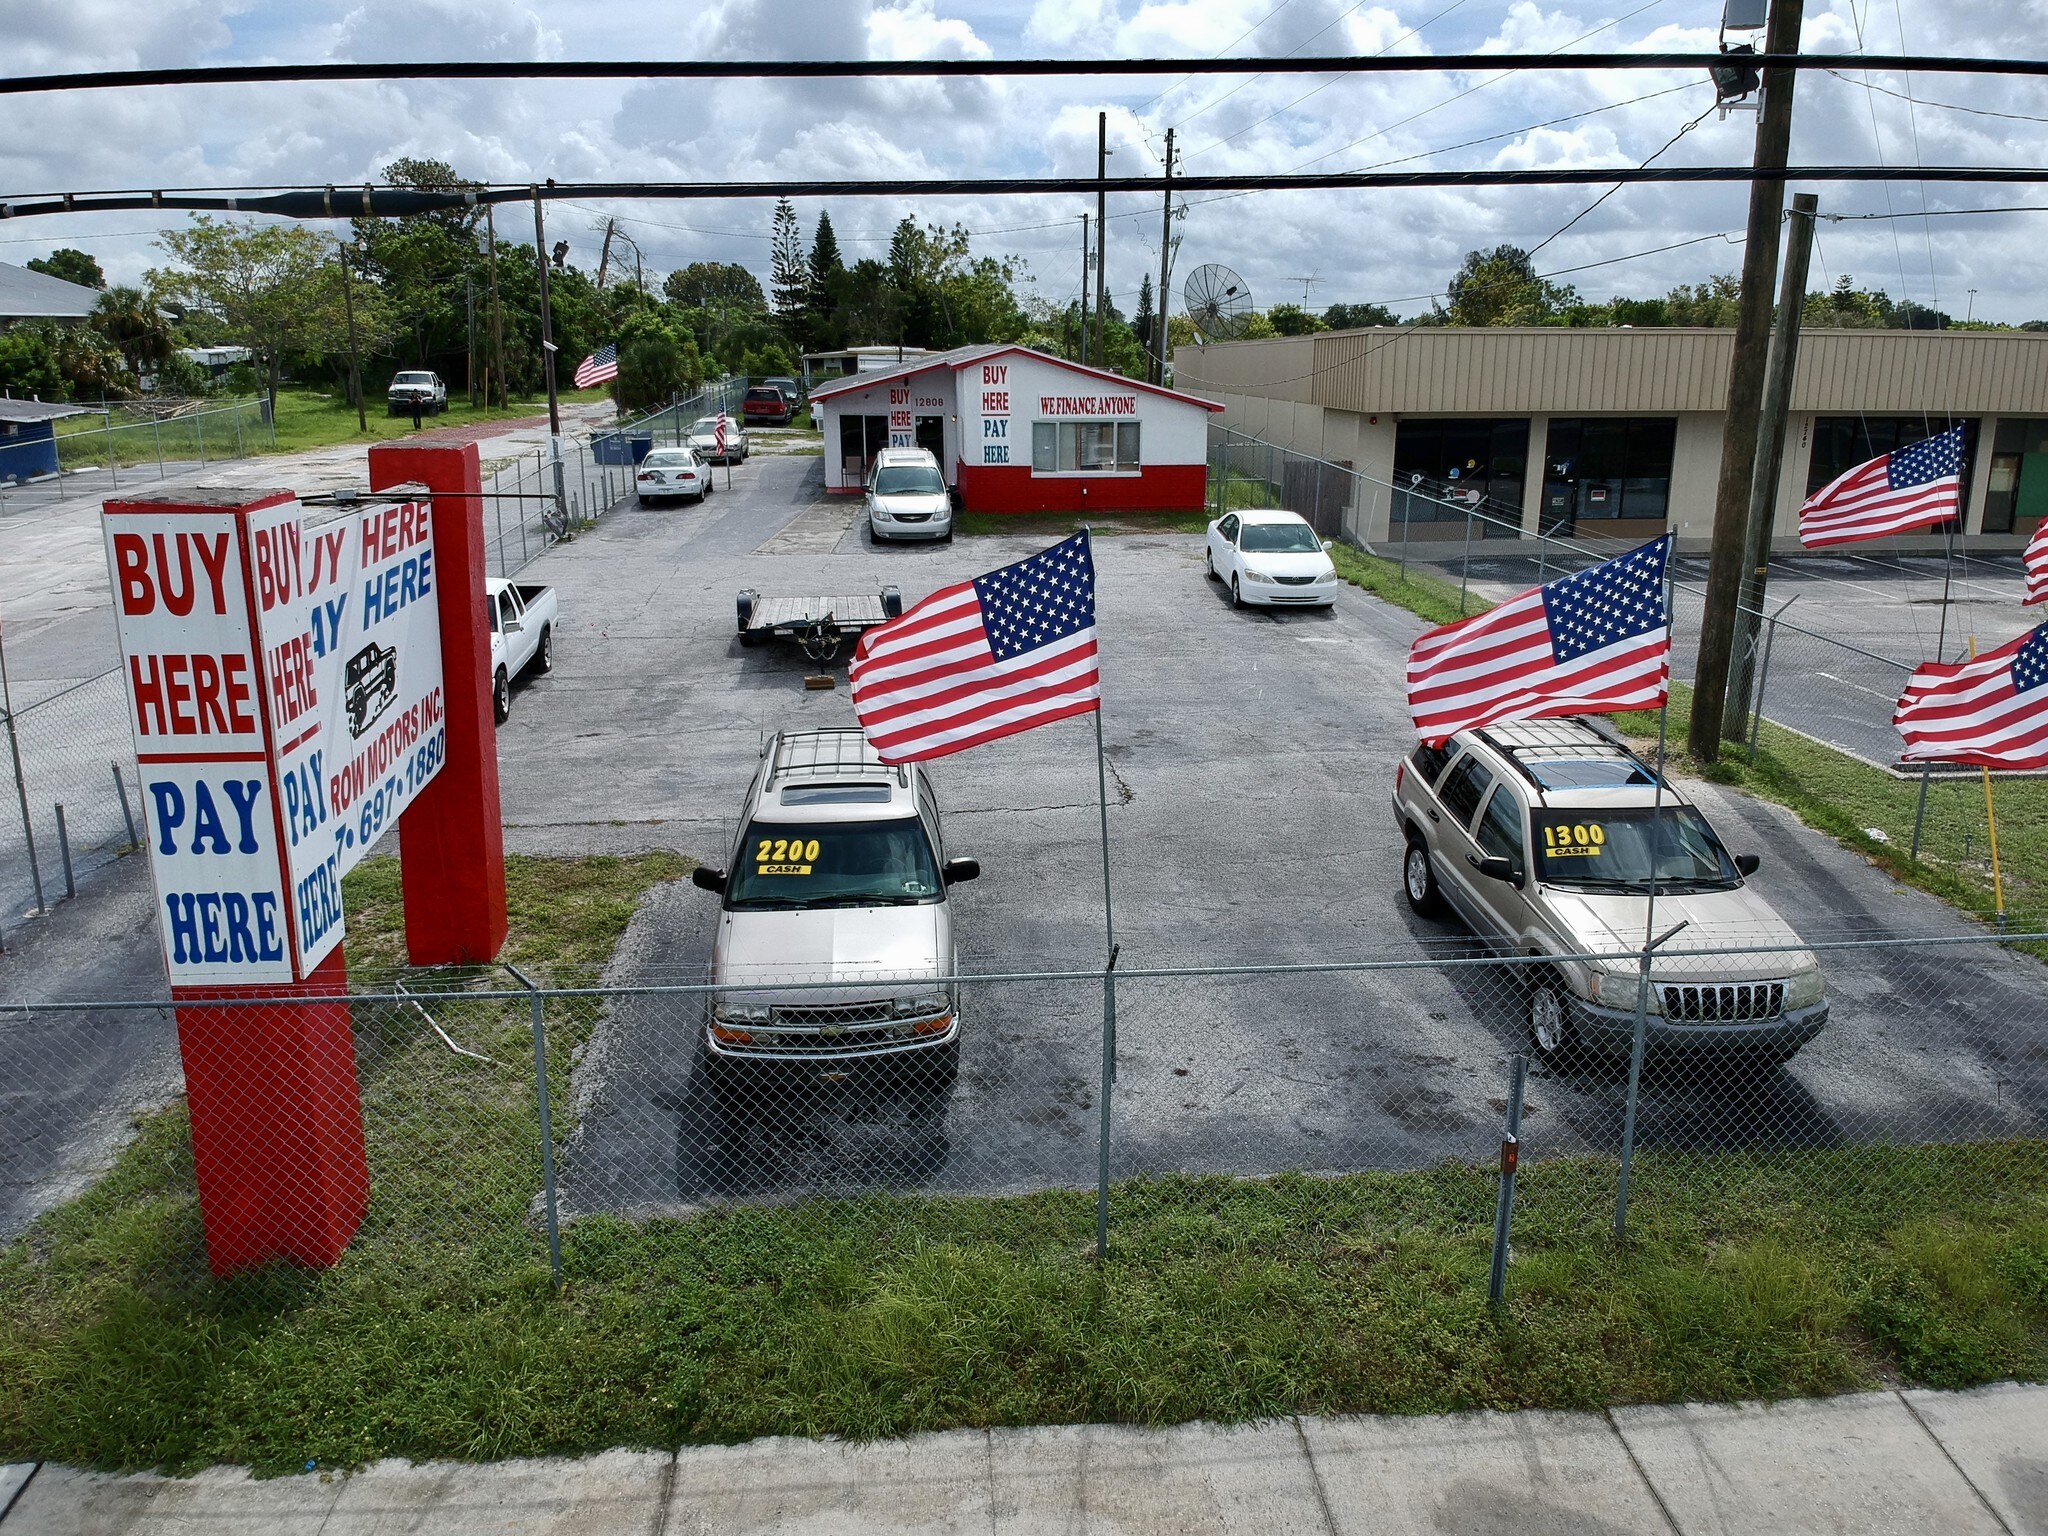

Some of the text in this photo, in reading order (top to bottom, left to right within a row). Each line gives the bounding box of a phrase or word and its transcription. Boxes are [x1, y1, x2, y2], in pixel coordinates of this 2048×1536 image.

[983, 365, 1008, 385] BUY
[890, 388, 911, 405] BUY
[915, 398, 944, 407] 12808
[982, 391, 1009, 411] HERE
[1040, 396, 1136, 415] WE FINANCE ANYONE
[891, 411, 911, 427] HERE
[984, 418, 1009, 438] PAY
[892, 434, 911, 448] PAY
[983, 445, 1010, 464] HERE
[304, 501, 428, 595] UY HERE
[114, 532, 230, 617] BUY
[255, 519, 303, 613] BUY
[311, 548, 432, 658] AY HERE
[268, 630, 317, 729] HERE
[130, 653, 256, 737] HERE
[330, 686, 443, 820] ROW MOTORS INC.
[284, 748, 327, 847] PAY
[149, 779, 262, 855] PAY
[1544, 824, 1605, 846] 1300
[756, 839, 820, 861] 2200
[1554, 847, 1590, 856] CASH
[766, 865, 802, 873] CASH
[298, 852, 341, 955] HERE
[166, 891, 284, 964] HERE
